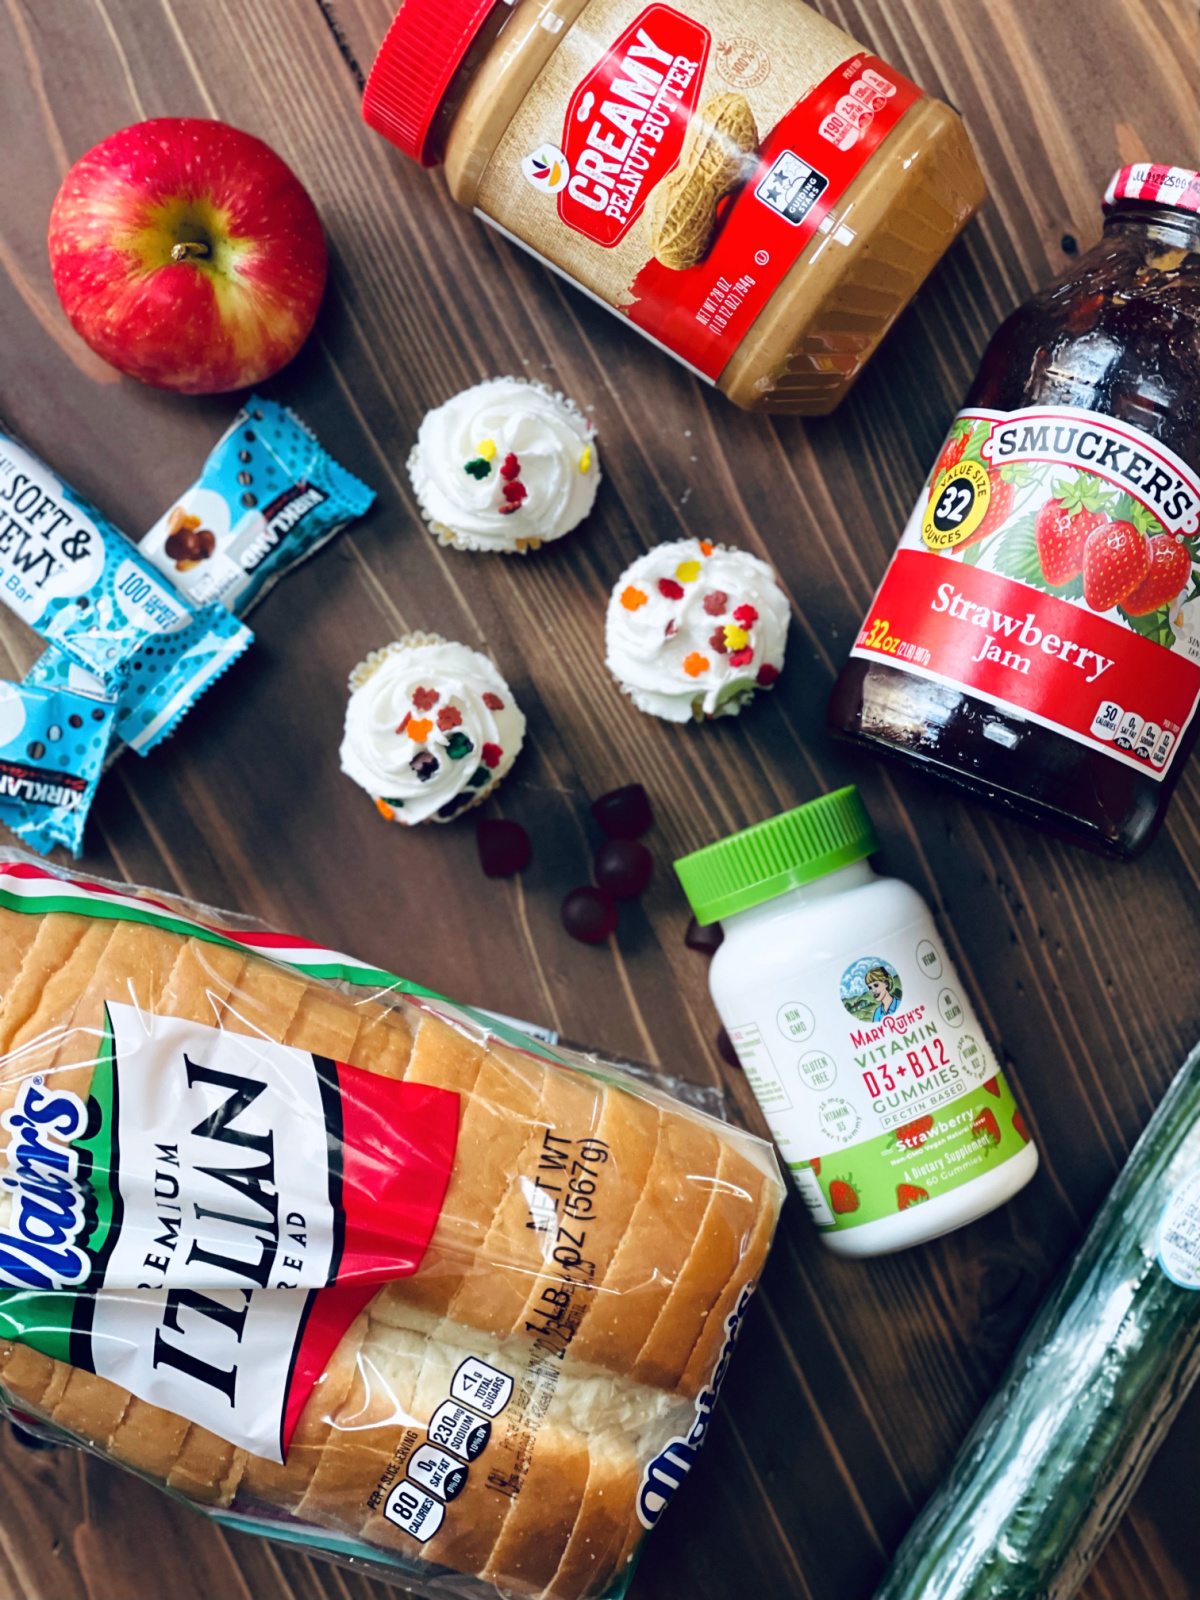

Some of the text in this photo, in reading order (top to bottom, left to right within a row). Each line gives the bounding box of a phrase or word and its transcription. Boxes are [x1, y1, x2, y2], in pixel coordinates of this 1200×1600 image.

[732, 51, 754, 75] 100%
[568, 28, 674, 211] CREAMY
[824, 116, 844, 138] 190
[606, 56, 698, 224] PEANUT BUTTER
[789, 178, 816, 214] GUIDING
[799, 187, 819, 213] STARS
[696, 276, 732, 325] NET WT 28 OZ
[732, 274, 756, 297] 794g
[719, 306, 733, 318] 12
[724, 293, 742, 310] OZ)
[712, 314, 728, 328] LB
[941, 465, 986, 498] VALUE SIZE
[999, 426, 1194, 520] SMUCKER'S
[1, 474, 90, 562] SOFT &
[936, 486, 972, 522] 32
[240, 488, 324, 569] KIRKLAND
[925, 524, 961, 544] OUNCES
[0, 509, 68, 588] EWY
[6, 574, 33, 604] Bar
[118, 572, 151, 604] 100
[930, 583, 1114, 683] Strawberry
[914, 646, 931, 666] 907g
[972, 634, 1032, 674] Jam
[1096, 716, 1117, 732] CALORIES
[1104, 705, 1118, 721] 50
[922, 952, 936, 966] VEGAN
[785, 1009, 801, 1022] NON
[944, 994, 952, 1006] NO
[945, 1005, 962, 1020] GELATIN
[790, 1021, 806, 1036] GMO
[854, 1021, 938, 1068] VITAMIN
[962, 1044, 978, 1059] VITAMIN
[802, 1056, 828, 1074] GLUTEN
[812, 1071, 830, 1086] FREE
[873, 1064, 960, 1114] GUMMIES
[824, 1106, 850, 1122] VITAMIN
[884, 1084, 964, 1126] PECTIN BASED
[822, 1128, 834, 1140] per
[842, 1116, 862, 1143] gummy
[836, 1121, 846, 1132] D3
[890, 1118, 986, 1166] Non-GMO Vegan Natural Flavor
[896, 1108, 974, 1152] Strawberry
[538, 1129, 572, 1170] WT
[904, 1134, 990, 1182] A Dietary Supplement
[562, 1138, 610, 1221] (567g)
[926, 1155, 983, 1187] 60 Gummies
[153, 1052, 279, 1409] ITLIAN
[553, 1226, 586, 1268] OZ
[533, 1287, 570, 1322] LB
[463, 1372, 482, 1391] <1g
[474, 1378, 493, 1399] TOTAL
[482, 1376, 505, 1410] SUGARS
[433, 1408, 465, 1444] 230mg
[450, 1415, 474, 1450] SODIUM
[470, 1428, 488, 1453] 10% DV
[366, 1492, 382, 1510] PER
[381, 1463, 400, 1486] SLICE
[394, 1430, 418, 1465] SERVING
[417, 1460, 437, 1472] 0g
[430, 1458, 451, 1488] SAT FAT
[446, 1473, 463, 1494] 0% DV
[392, 1492, 418, 1520] 80
[408, 1498, 434, 1534] CALORIES
